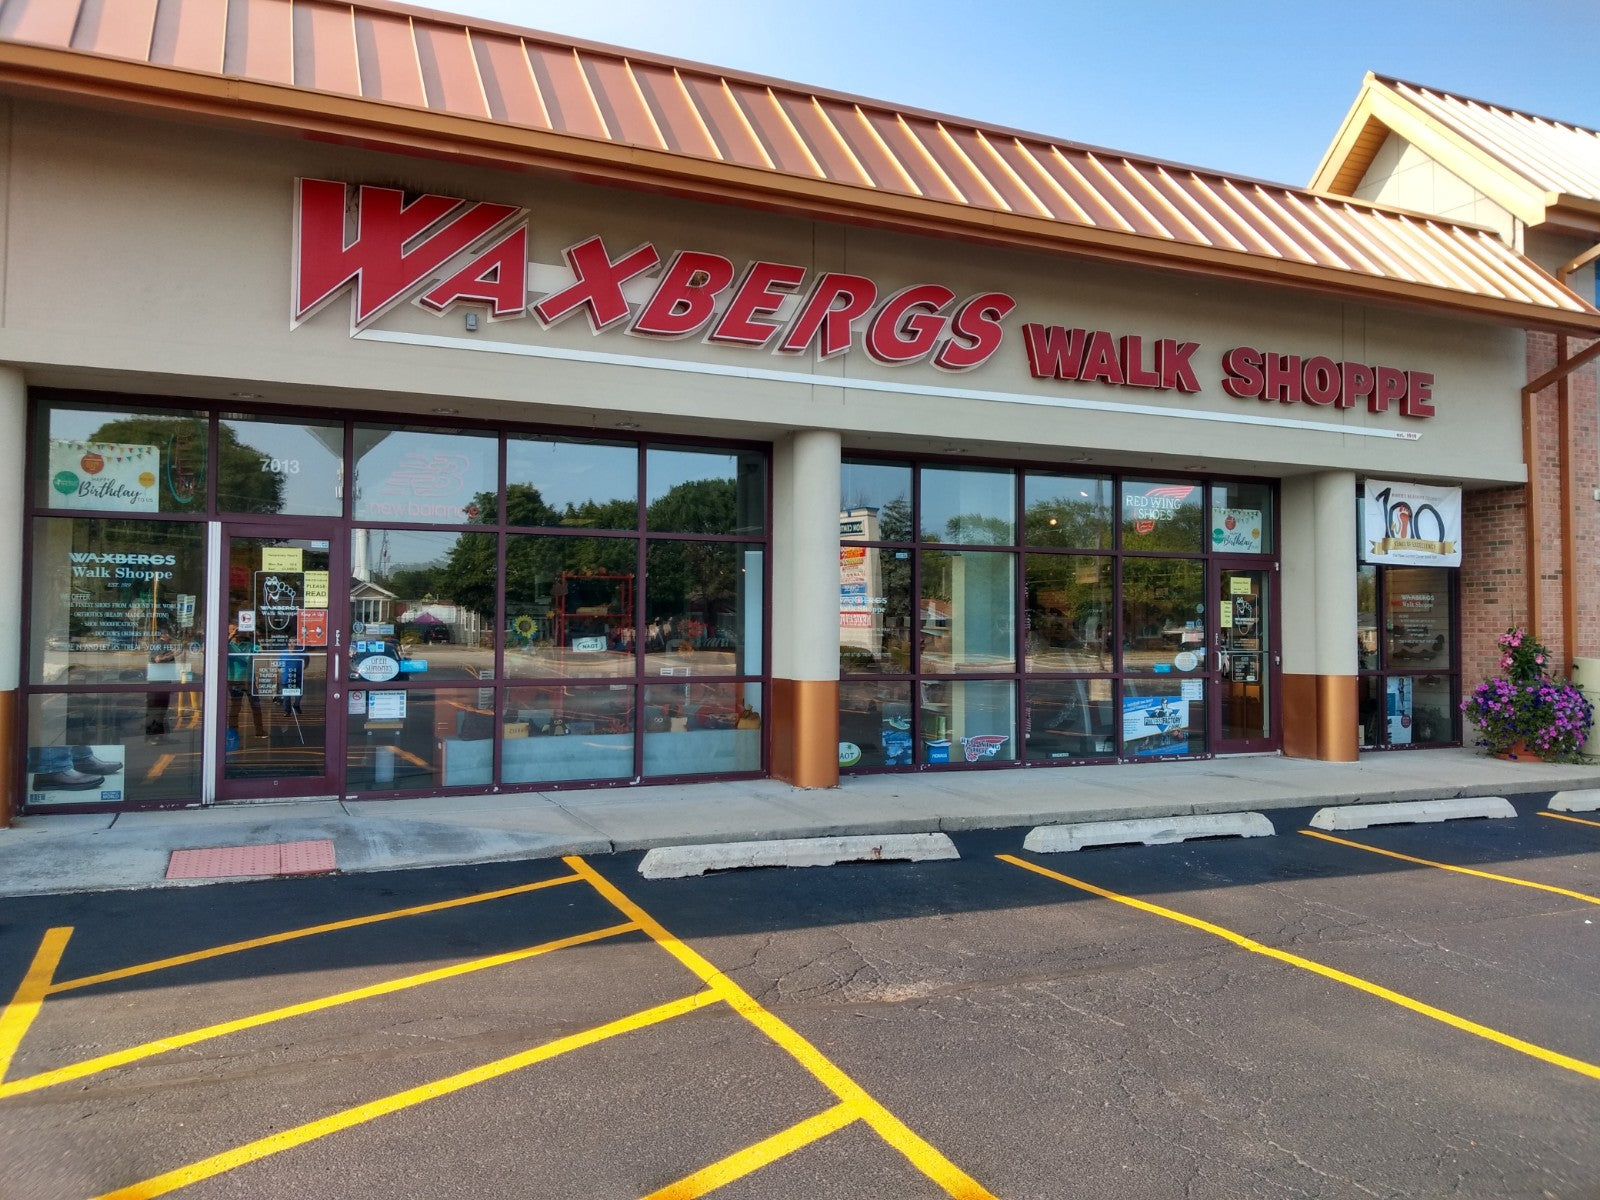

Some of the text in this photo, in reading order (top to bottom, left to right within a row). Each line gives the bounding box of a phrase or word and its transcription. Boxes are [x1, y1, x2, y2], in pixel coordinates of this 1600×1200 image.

[291, 177, 1436, 419] WAXBERGS WALK SHOPPE
[259, 458, 300, 474] 7013
[78, 478, 141, 505] Birthday
[1126, 495, 1181, 510] RED WING
[1138, 508, 1173, 520] SHOES
[68, 552, 176, 566] WAXBERGS
[72, 566, 173, 582] Walk Shoppe
